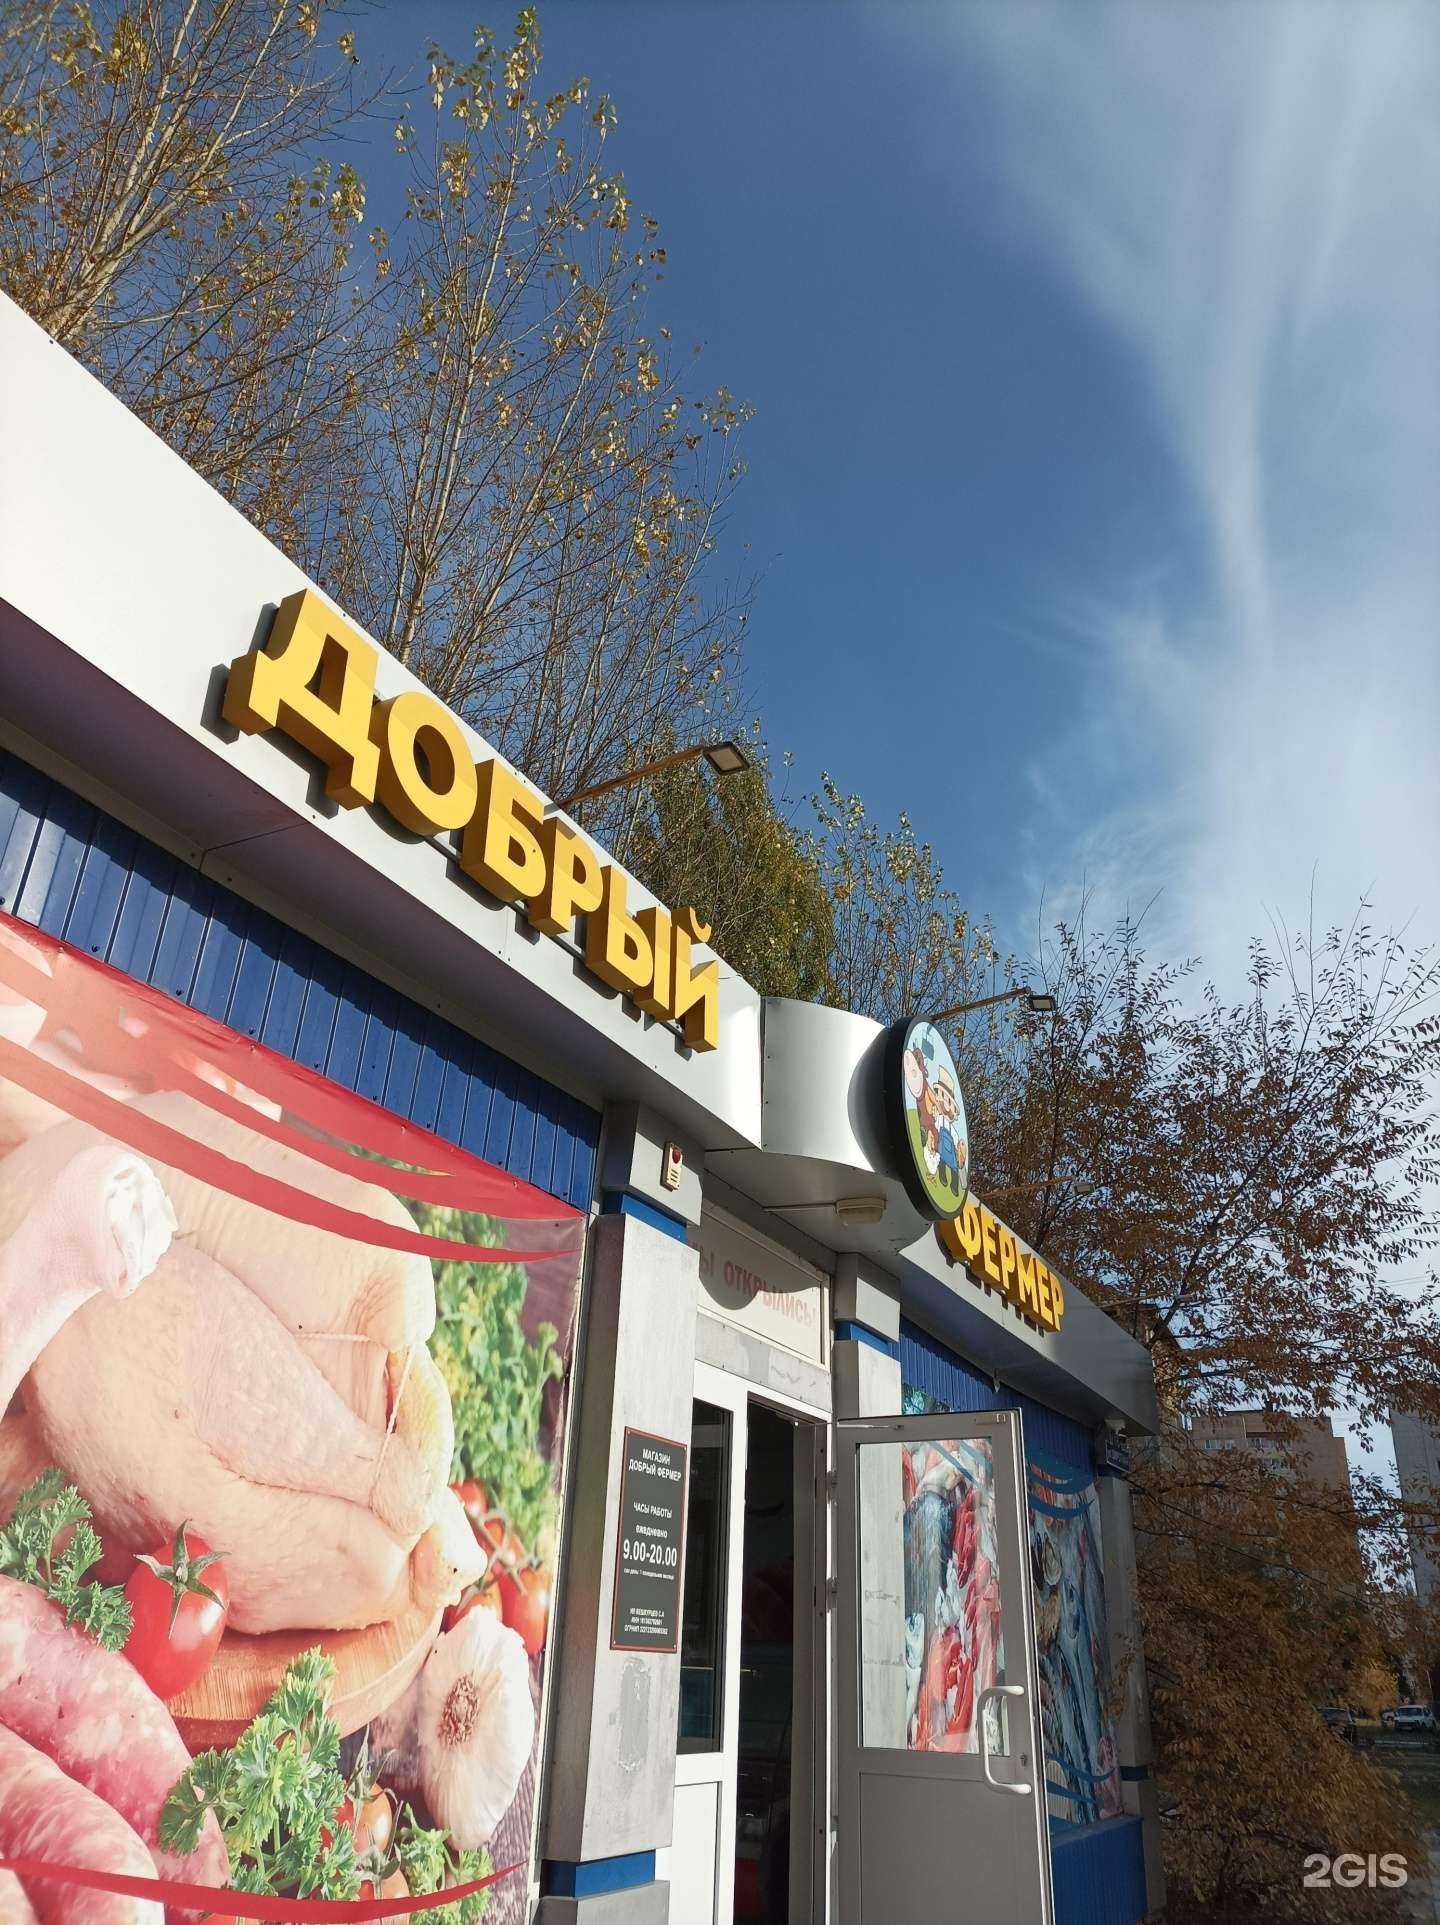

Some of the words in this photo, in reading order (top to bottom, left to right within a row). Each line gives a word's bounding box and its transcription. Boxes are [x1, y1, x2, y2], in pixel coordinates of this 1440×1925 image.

[226, 588, 719, 1053] ДОБРЫЙ
[944, 1200, 1065, 1333] ФЕРМЕР
[642, 1448, 671, 1465] МАГАЗИН
[628, 1459, 656, 1476] ДОБРЫЙ
[657, 1467, 682, 1481] ФЕРМЕР
[633, 1501, 650, 1514] ЧАСЫ
[650, 1505, 673, 1518] РАБОТЫ
[623, 1539, 677, 1567] 9.00-20.00
